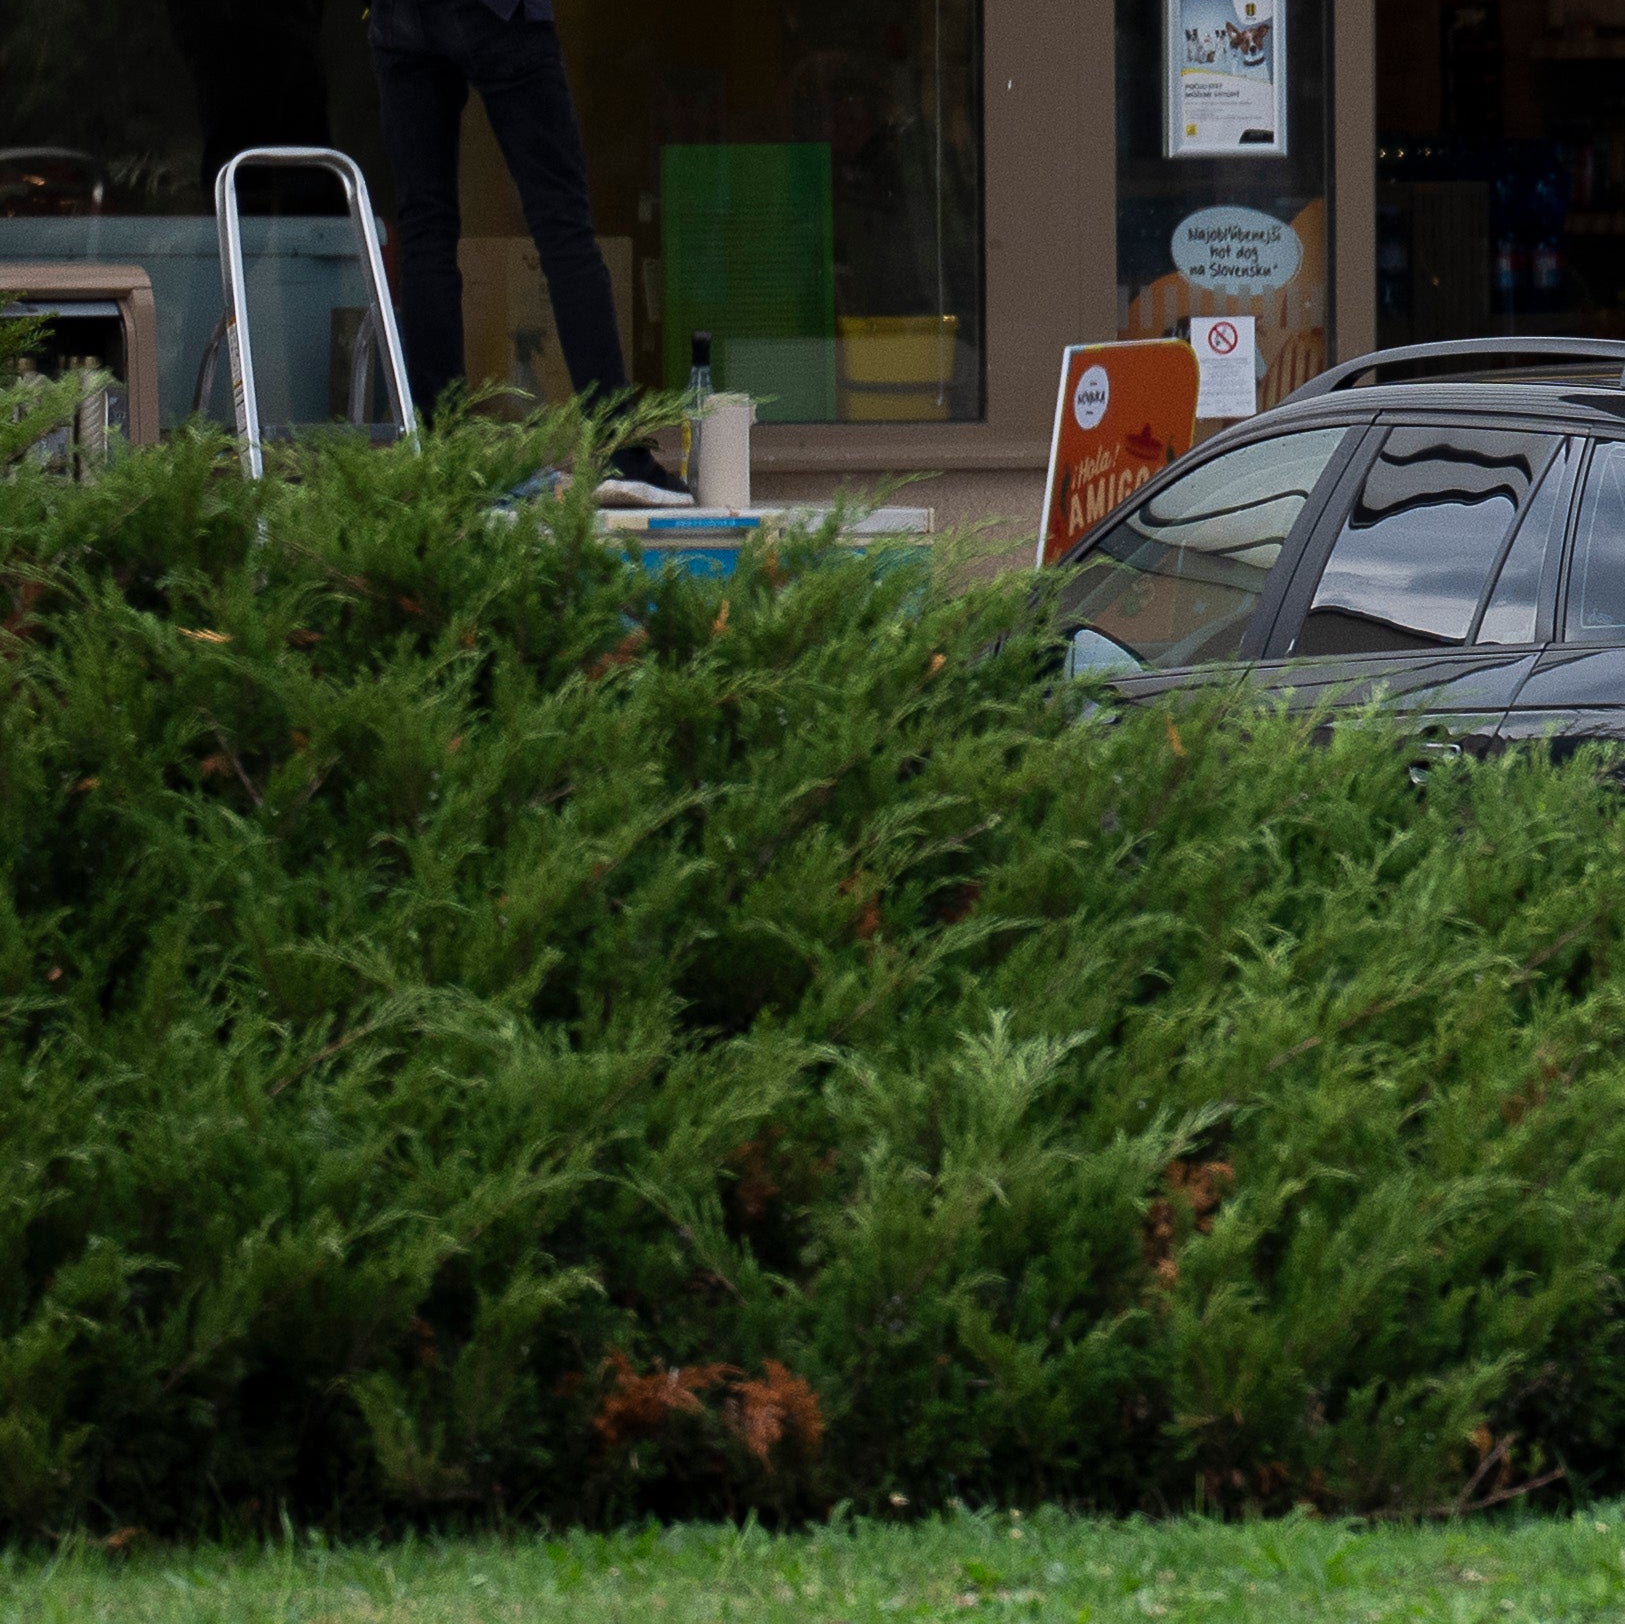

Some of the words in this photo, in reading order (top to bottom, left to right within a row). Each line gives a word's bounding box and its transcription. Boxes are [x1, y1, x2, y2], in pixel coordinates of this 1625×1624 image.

[1209, 245, 1232, 259] hot
[1236, 245, 1259, 263] dog
[1188, 265, 1206, 277] na
